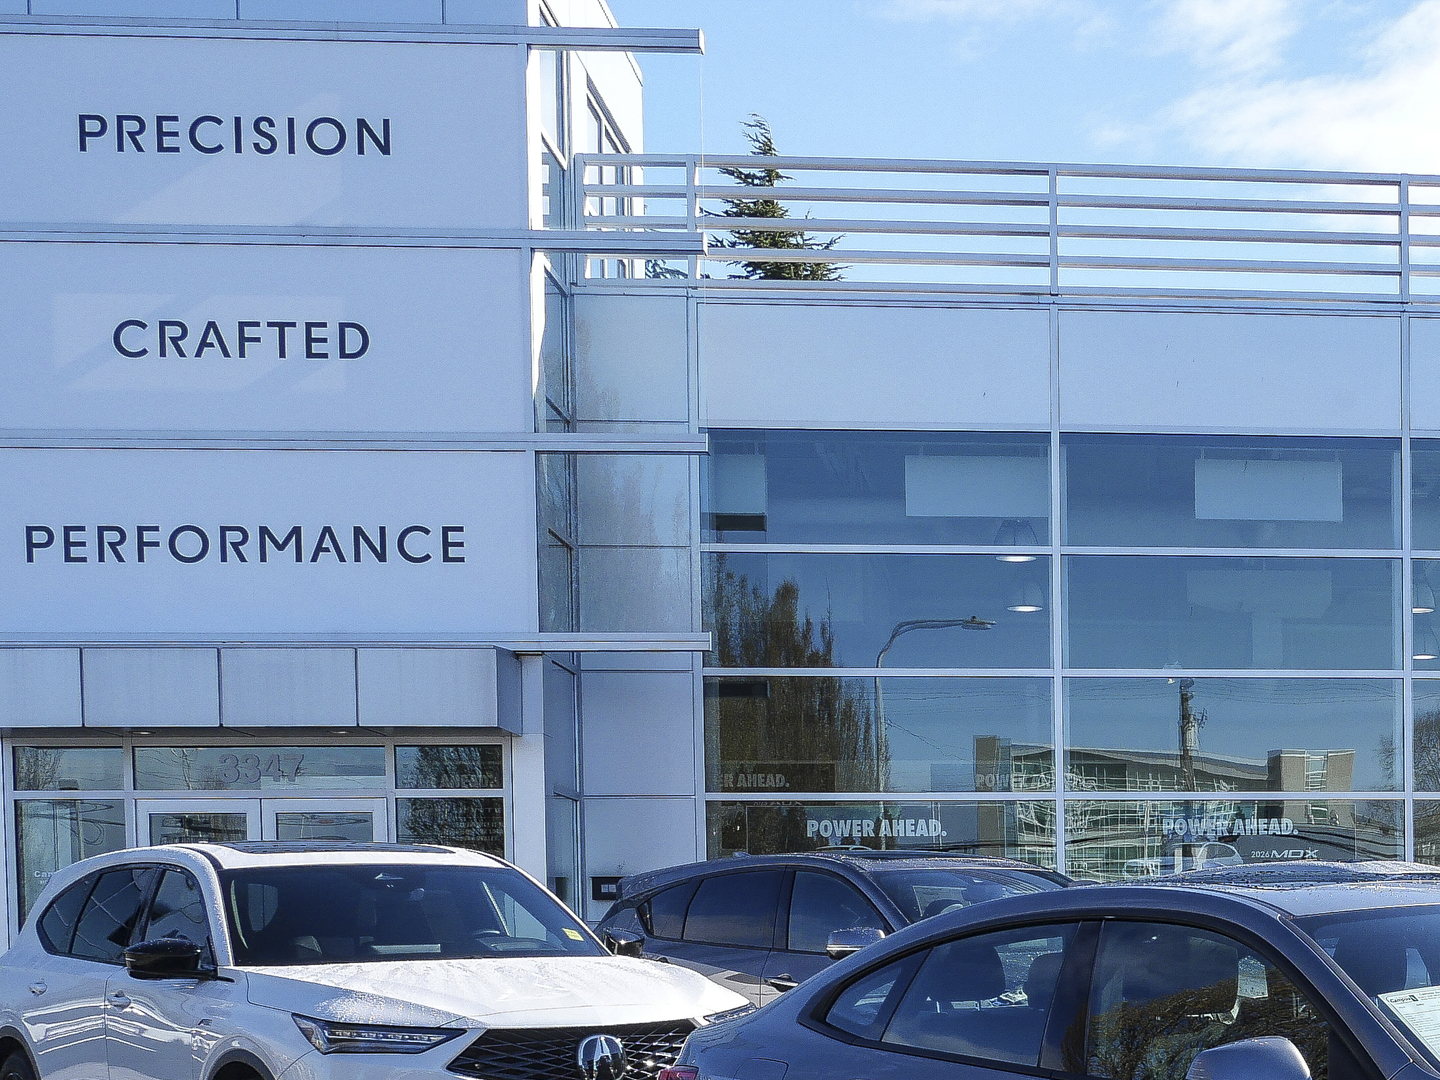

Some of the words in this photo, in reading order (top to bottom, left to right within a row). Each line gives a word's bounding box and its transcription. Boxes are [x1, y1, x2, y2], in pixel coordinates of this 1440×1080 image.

[78, 114, 391, 156] PRECISION
[113, 319, 370, 360] CRAFTED
[25, 524, 466, 564] PERFORMANCE
[219, 754, 304, 783] 3347
[806, 819, 875, 837] POWER
[879, 818, 948, 837] AHEAD.
[1163, 818, 1229, 835] POWER
[1232, 818, 1299, 836] AHEAD.
[1251, 851, 1270, 859] 2026
[1271, 849, 1317, 859] MDX
